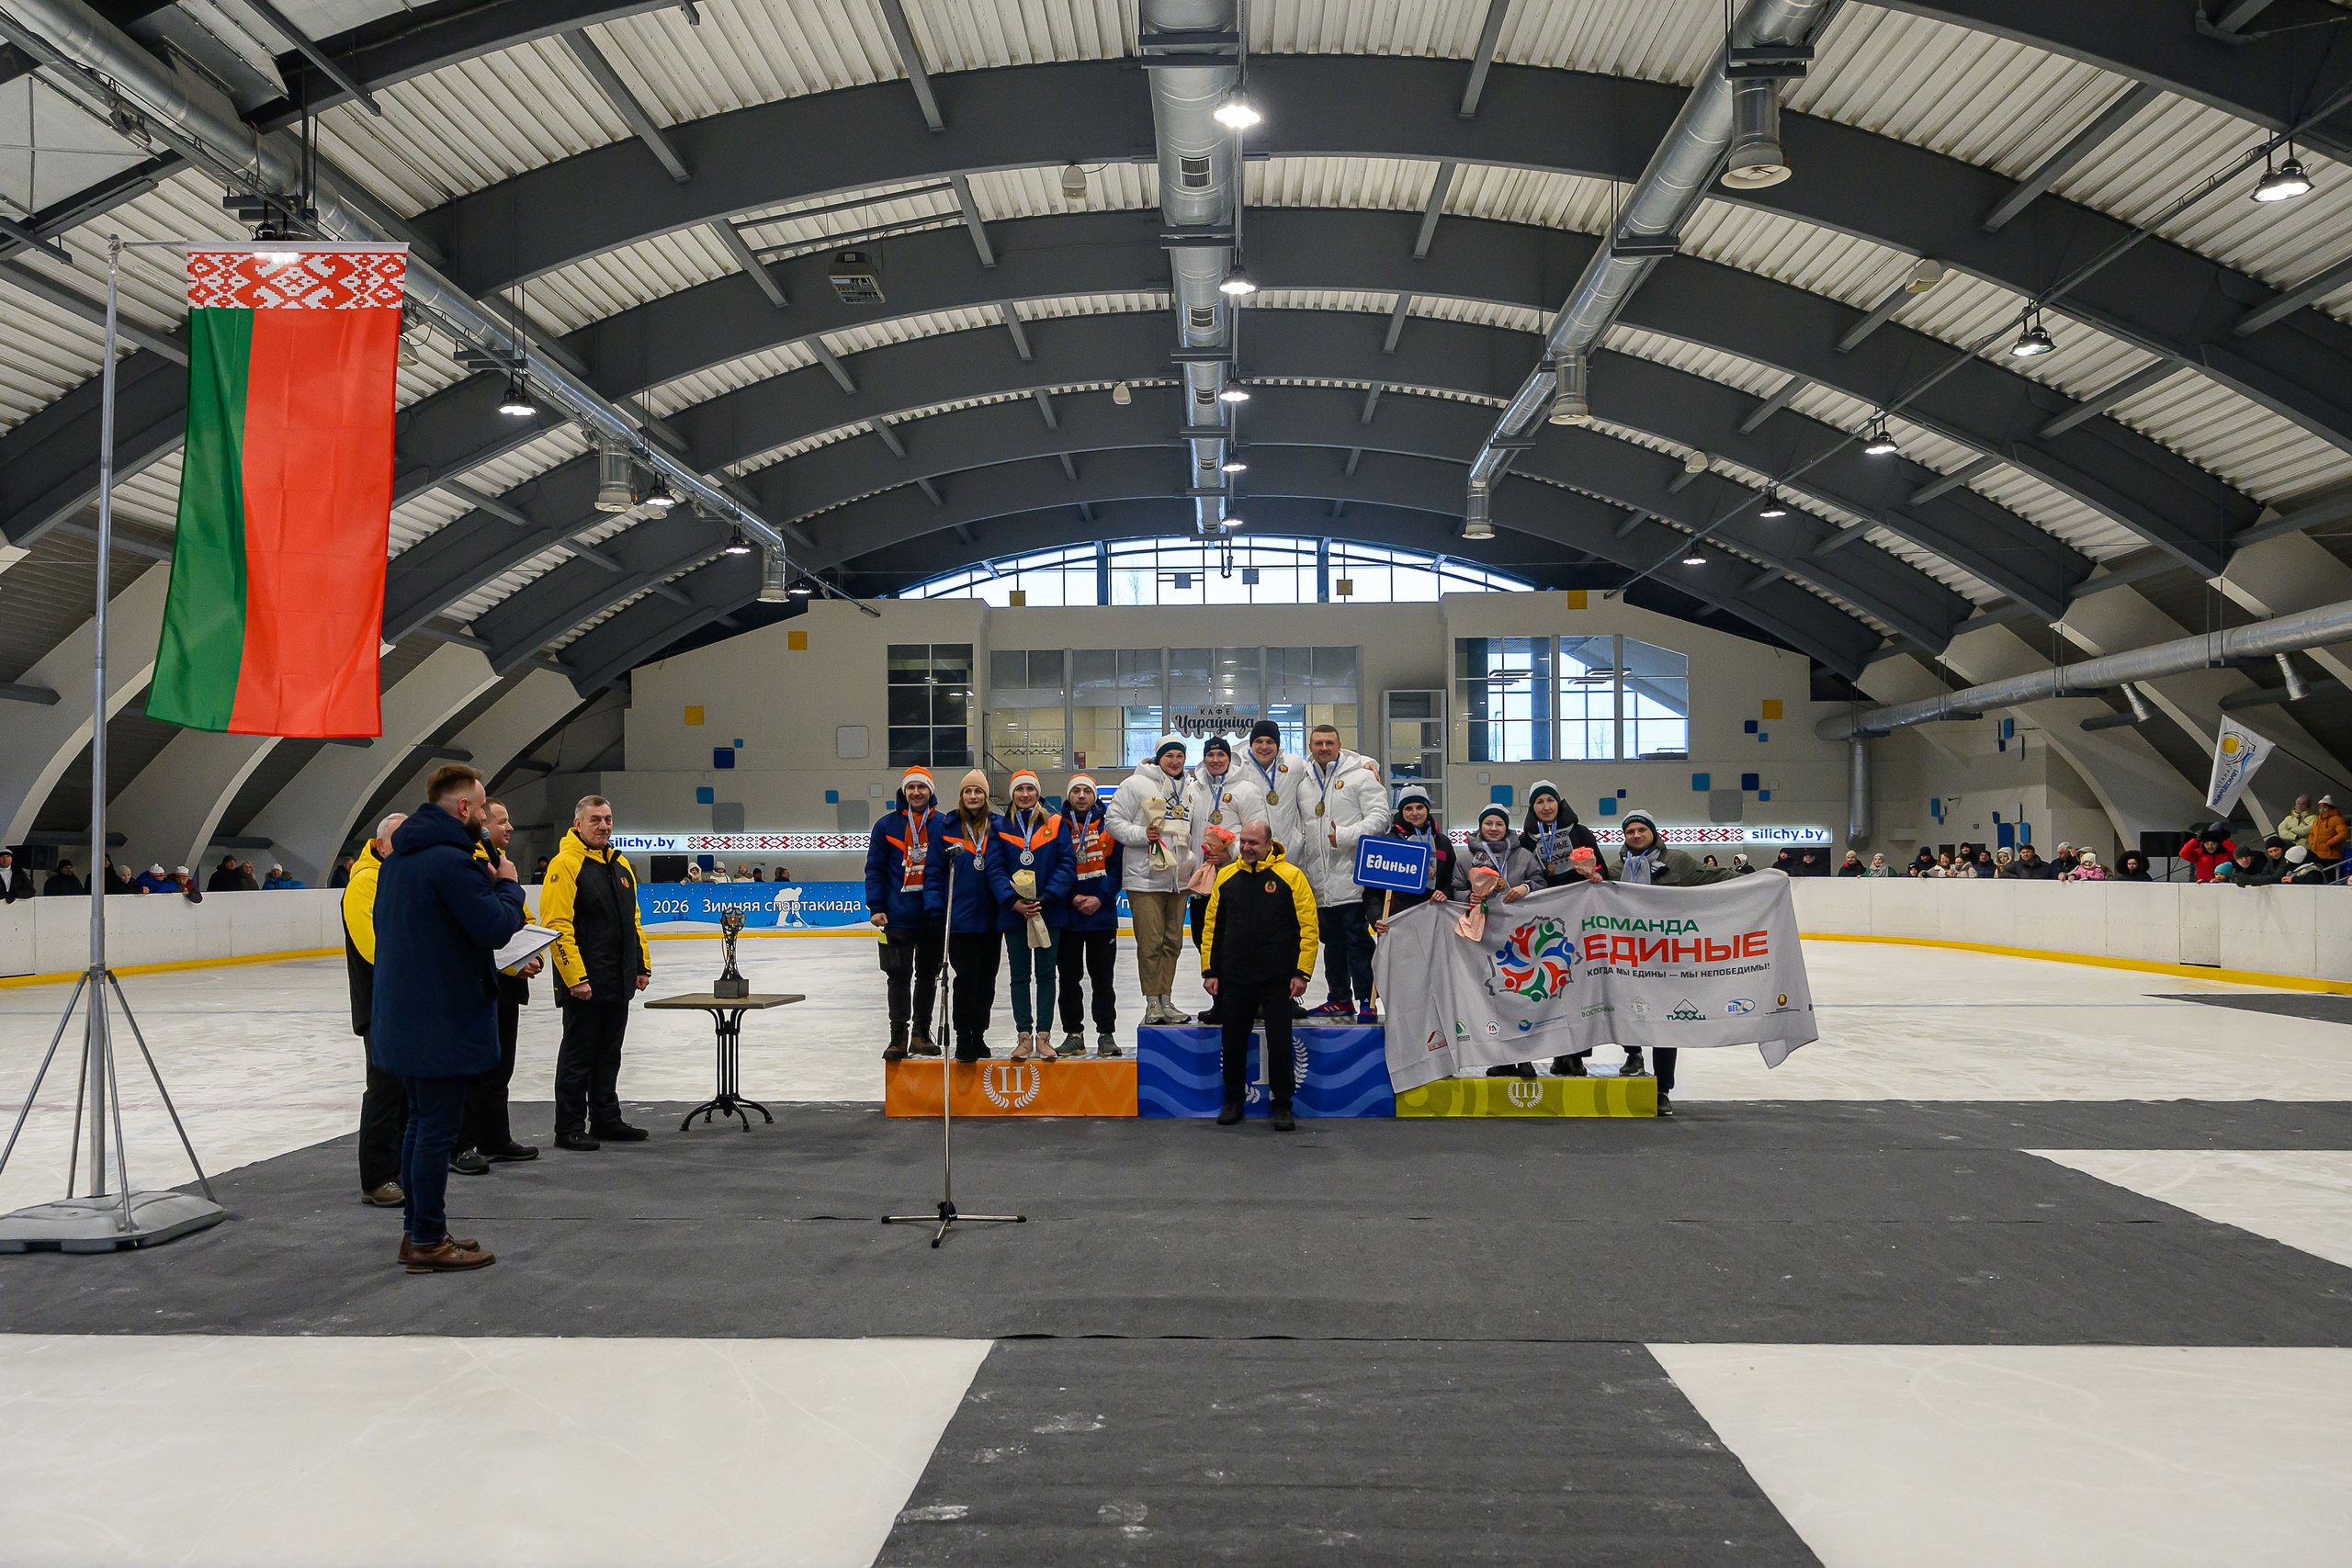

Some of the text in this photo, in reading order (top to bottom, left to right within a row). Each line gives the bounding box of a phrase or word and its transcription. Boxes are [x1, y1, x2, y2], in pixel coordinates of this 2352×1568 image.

[608, 837, 675, 849] silichy.by
[1752, 829, 1824, 840] silichy.by
[1365, 853, 1418, 874] Единые
[652, 899, 689, 914] 2026
[702, 898, 761, 913] Зимняя
[764, 899, 861, 915] спартакиада
[1581, 916, 1700, 935] КОМАНДА
[1583, 930, 1769, 967] ЕДИНЫЕ
[1587, 966, 1613, 977] КОГДА
[1616, 967, 1630, 976] МЫ
[1632, 970, 1667, 978] ЕДИНЫ
[1701, 963, 1770, 977] НЕПОБЕДИМЫ!
[997, 1066, 1025, 1093] II
[1513, 1081, 1538, 1099] III
